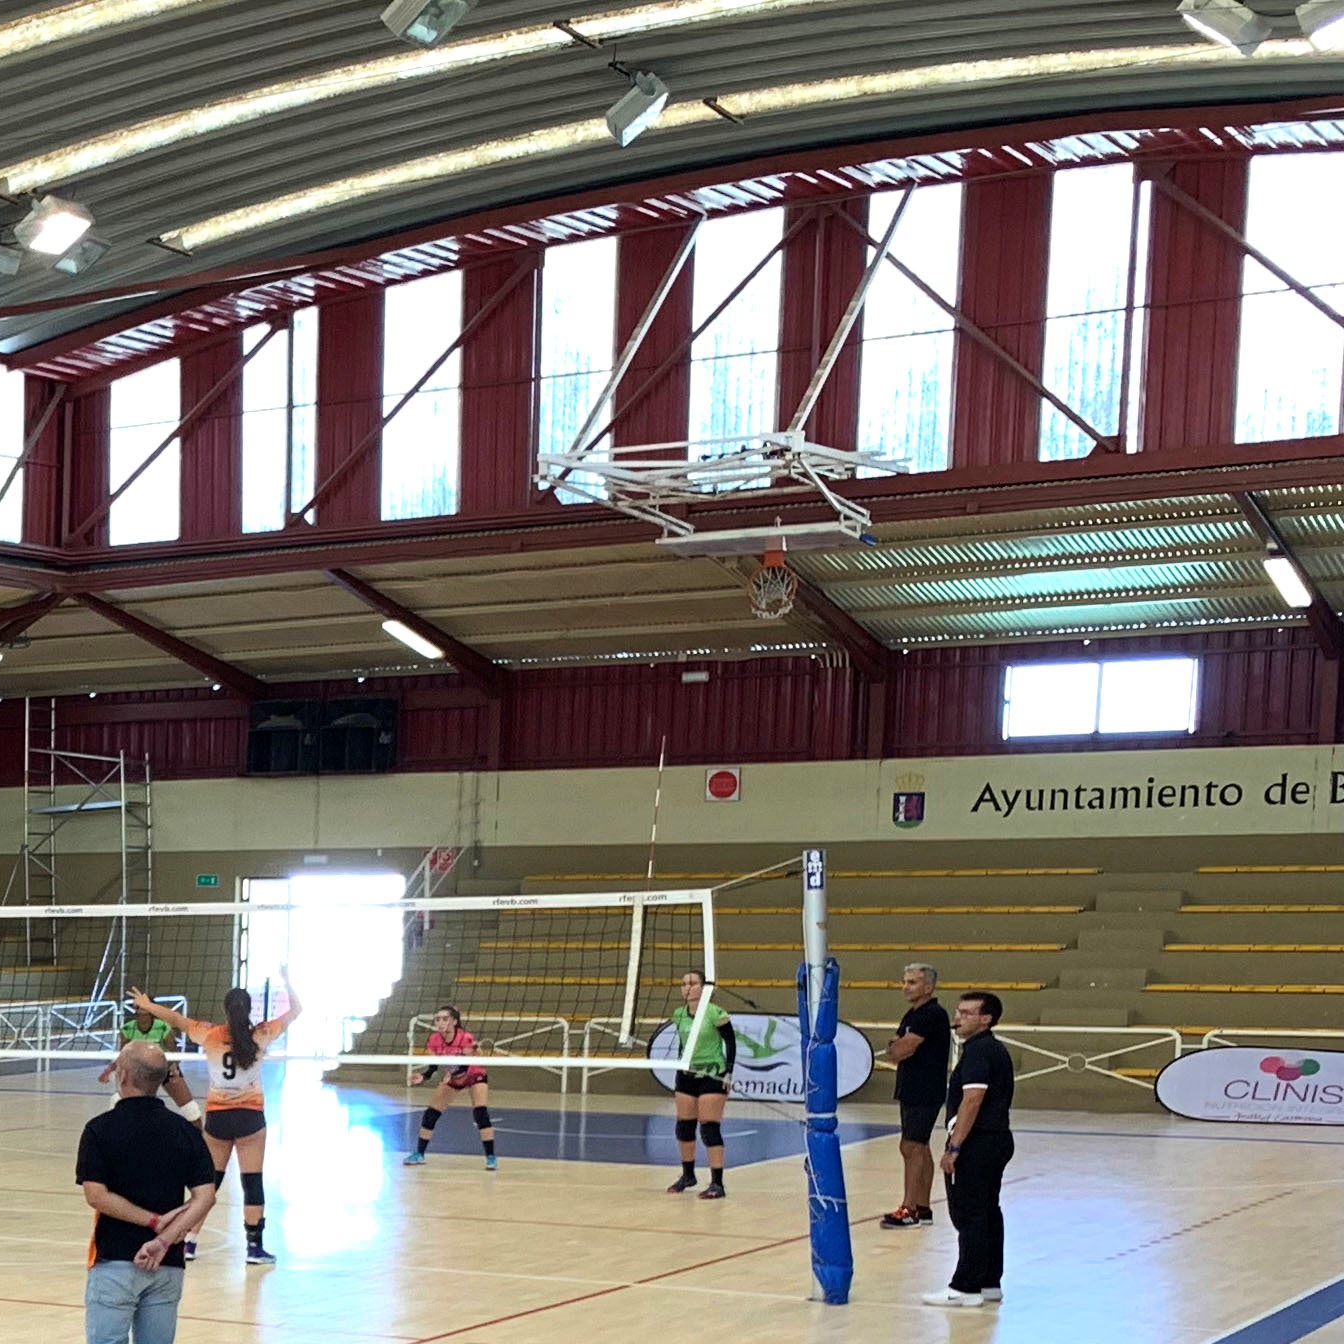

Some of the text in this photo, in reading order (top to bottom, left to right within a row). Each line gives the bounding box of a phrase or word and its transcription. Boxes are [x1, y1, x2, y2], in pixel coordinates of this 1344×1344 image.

[970, 776, 1243, 817] Ayuntamiento
[1263, 773, 1310, 805] de
[223, 1052, 237, 1080] 9
[1224, 1079, 1344, 1104] CLINIS
